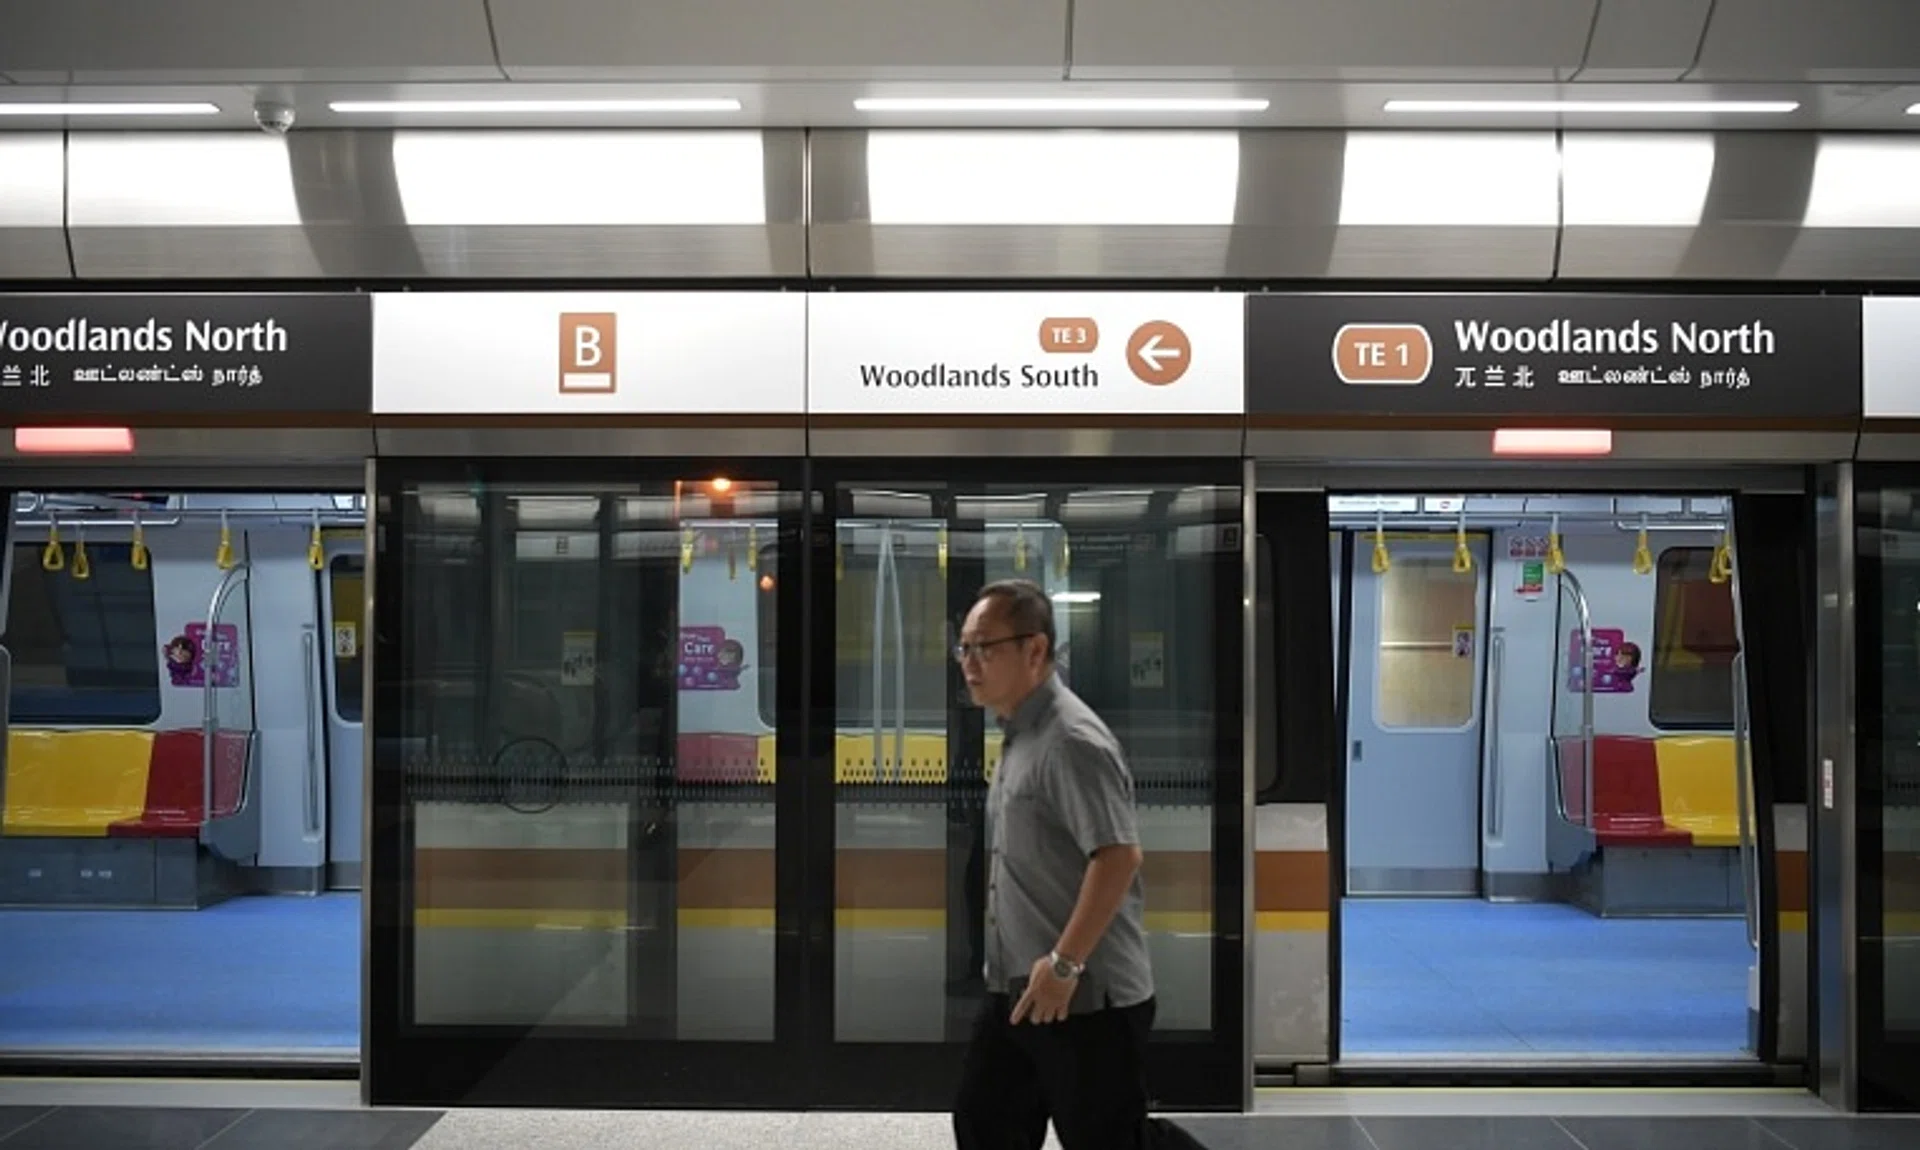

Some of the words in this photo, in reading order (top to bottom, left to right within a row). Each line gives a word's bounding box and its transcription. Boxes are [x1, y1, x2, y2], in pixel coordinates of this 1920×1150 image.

[185, 318, 288, 352] North
[575, 325, 602, 367] B
[1051, 327, 1072, 344] TE
[1076, 327, 1087, 344] 3
[1453, 318, 1660, 354] Woodlands
[1671, 319, 1776, 354] North
[1354, 342, 1386, 366] TE
[1396, 342, 1410, 366] 1
[859, 363, 1011, 387] Woodlands
[1020, 364, 1099, 387] South
[1454, 365, 1535, 388] 兀兰北
[684, 642, 715, 655] Care
